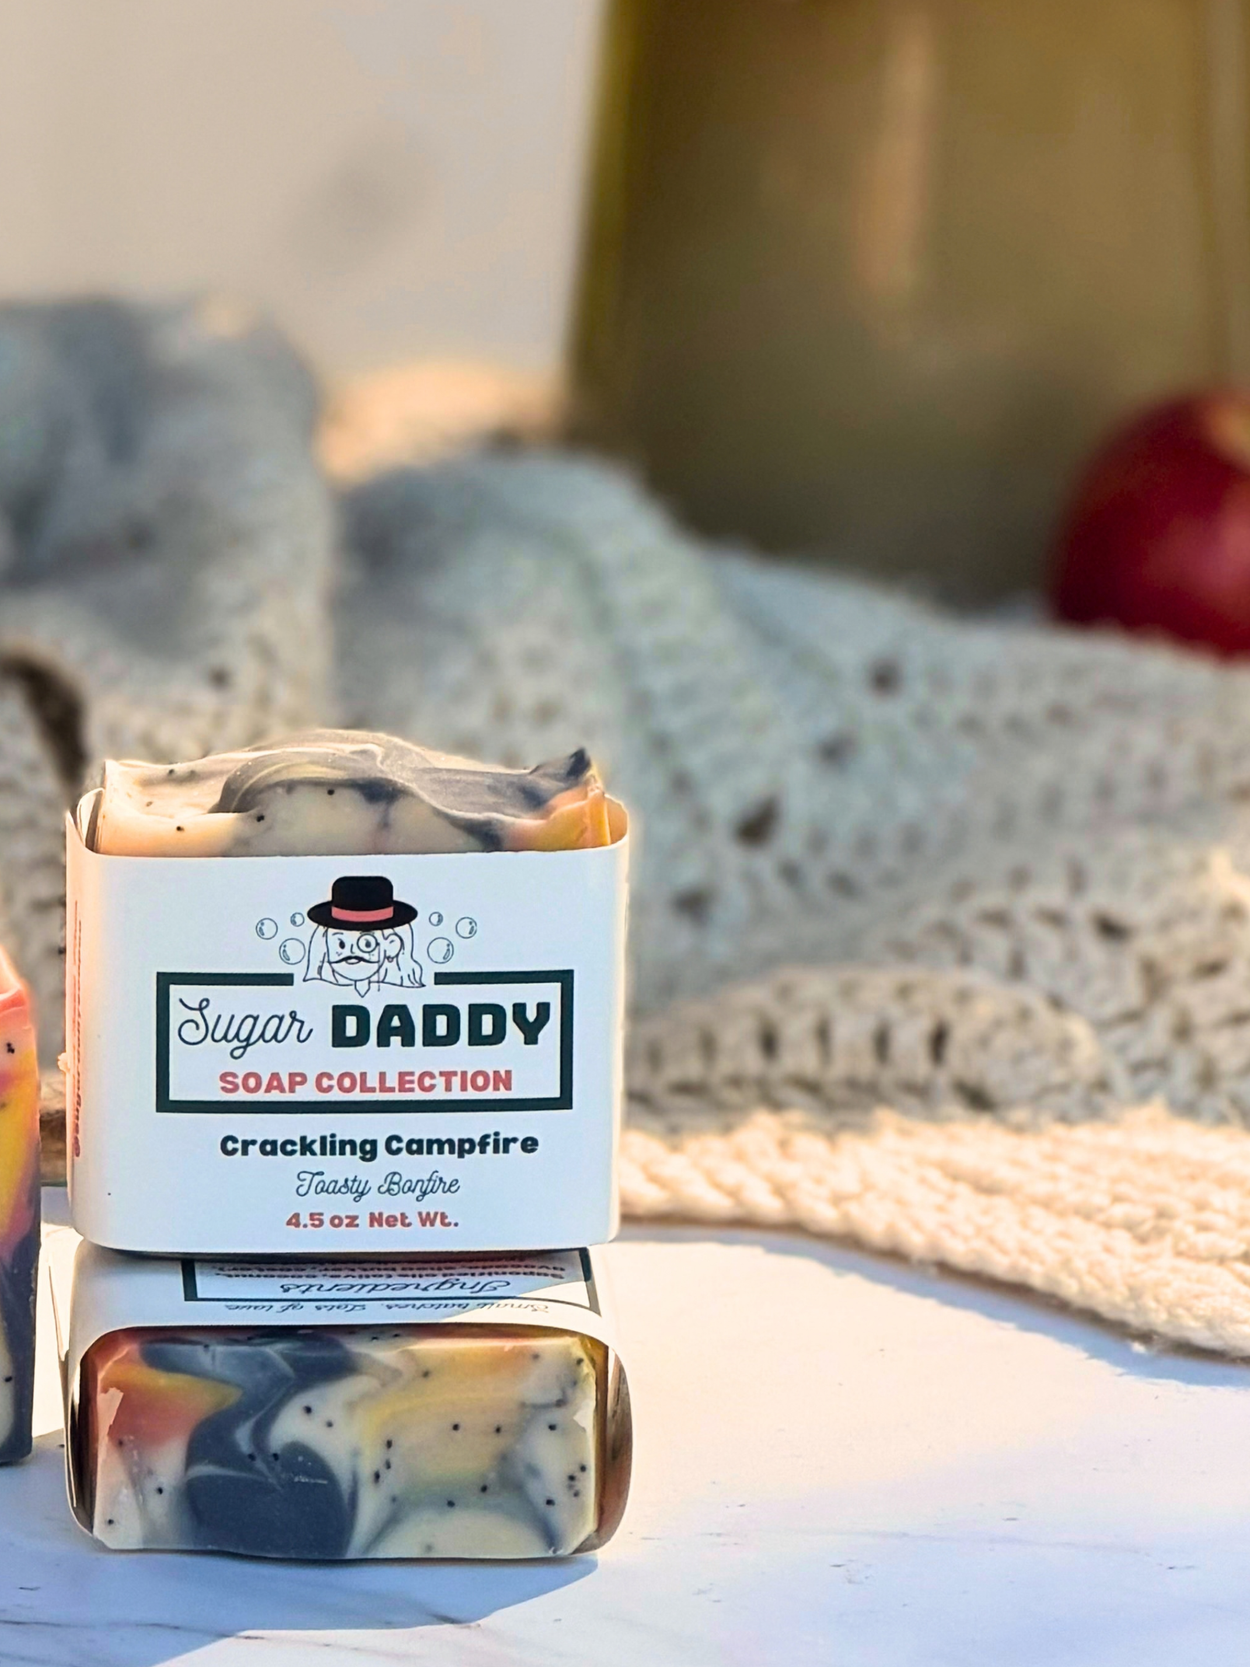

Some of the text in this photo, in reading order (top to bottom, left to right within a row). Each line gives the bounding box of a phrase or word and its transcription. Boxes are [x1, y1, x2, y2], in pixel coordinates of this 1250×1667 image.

[177, 997, 551, 1060] Sugar DADDY
[219, 1070, 513, 1094] SOAP COLLECTION
[220, 1131, 540, 1162] Crackling Campfire
[296, 1170, 461, 1203] Toasty Bonfire
[285, 1211, 459, 1229] 4.5 oz Net Wt.
[279, 1277, 511, 1295] Ingredients
[275, 1303, 304, 1314] of
[314, 1303, 366, 1313] Lots
